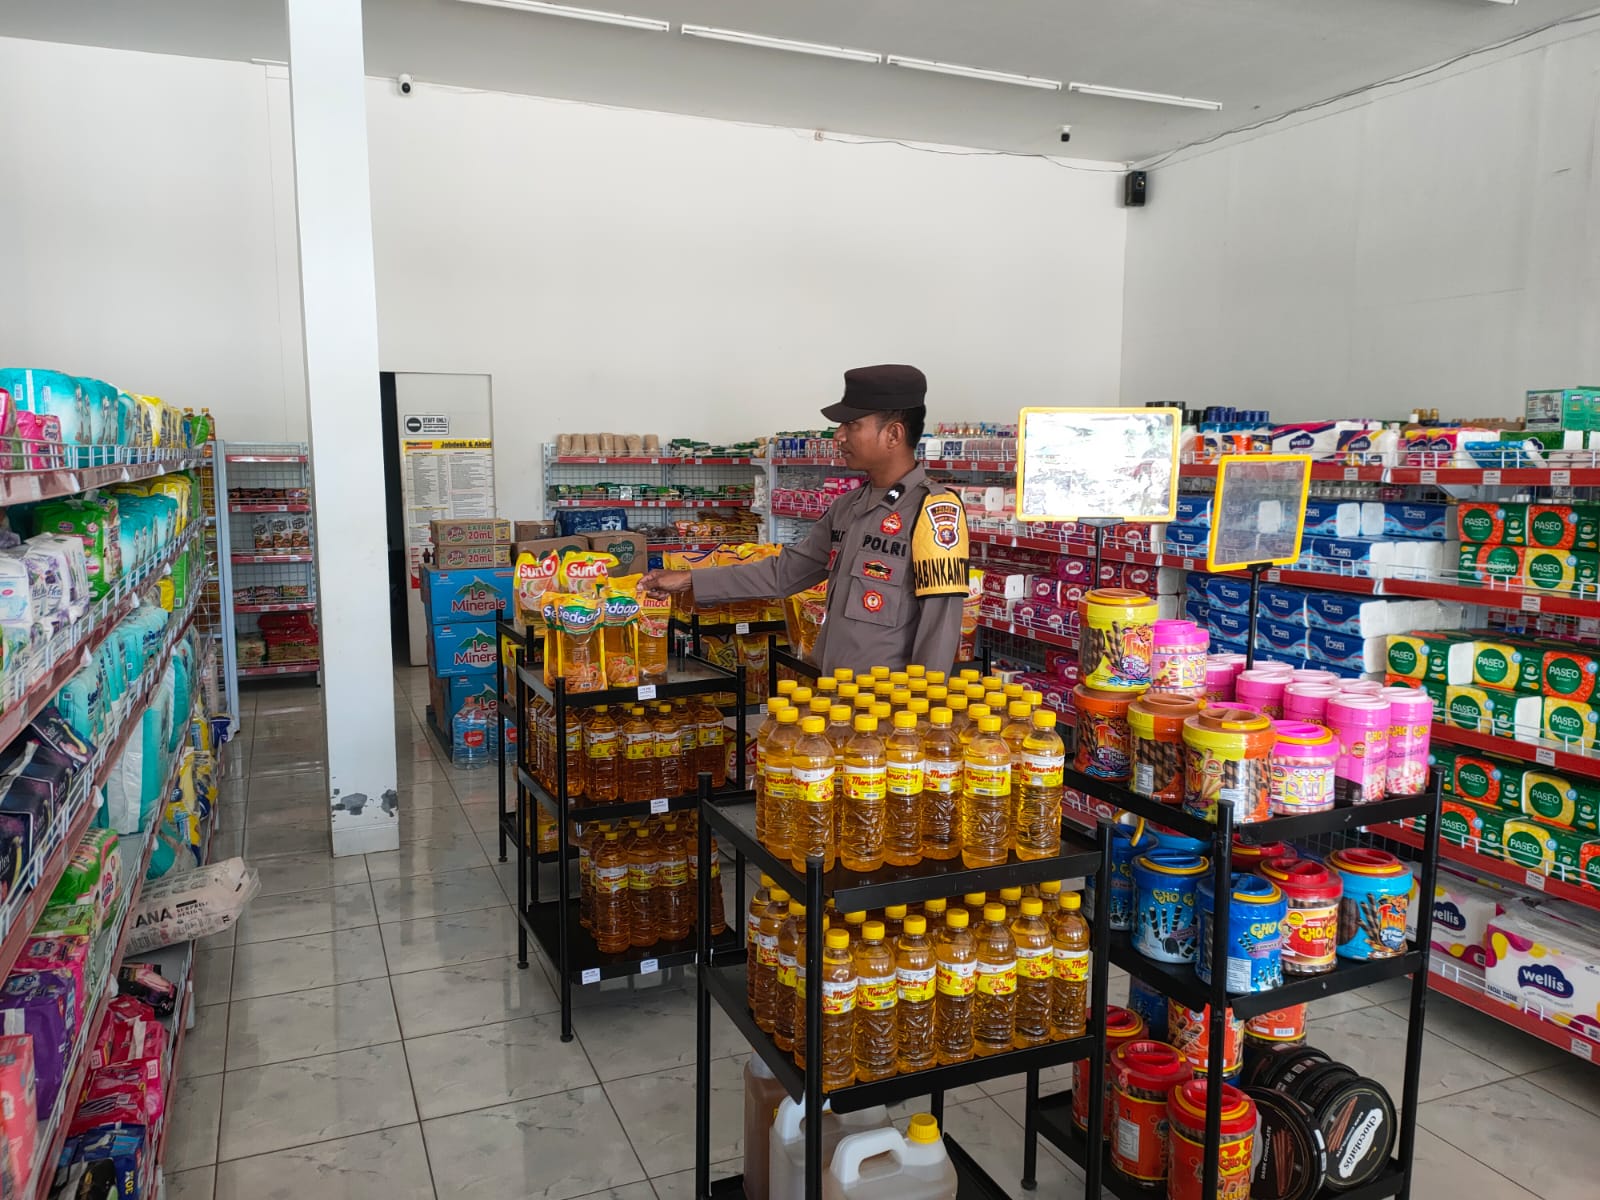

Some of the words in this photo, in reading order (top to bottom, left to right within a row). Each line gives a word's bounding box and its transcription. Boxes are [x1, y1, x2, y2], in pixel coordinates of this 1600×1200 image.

[1464, 517, 1491, 527] PASEO
[1534, 521, 1561, 531] PASEO
[863, 534, 907, 557] POLRI
[1532, 563, 1560, 573] PASEO
[471, 587, 486, 601] Le
[452, 598, 506, 613] Minerale
[558, 605, 602, 624] Sedaap
[473, 639, 488, 653] Le
[454, 652, 497, 665] Minera
[1390, 649, 1415, 660] PASEO
[1477, 656, 1505, 670] PASEO
[1549, 665, 1580, 679] PASEO
[480, 698, 497, 711] Le
[1452, 703, 1479, 716] PASEO
[1551, 714, 1581, 728] PASEO
[1459, 771, 1487, 784] PASEO
[1532, 789, 1560, 804] PASEO
[1441, 818, 1468, 833] PASEO
[1510, 838, 1540, 854] PASEO
[131, 907, 173, 929] ANA
[1522, 969, 1565, 992] wellis
[1263, 1125, 1272, 1162] CHOCOLATE
[1344, 1115, 1377, 1170] chocolatos
